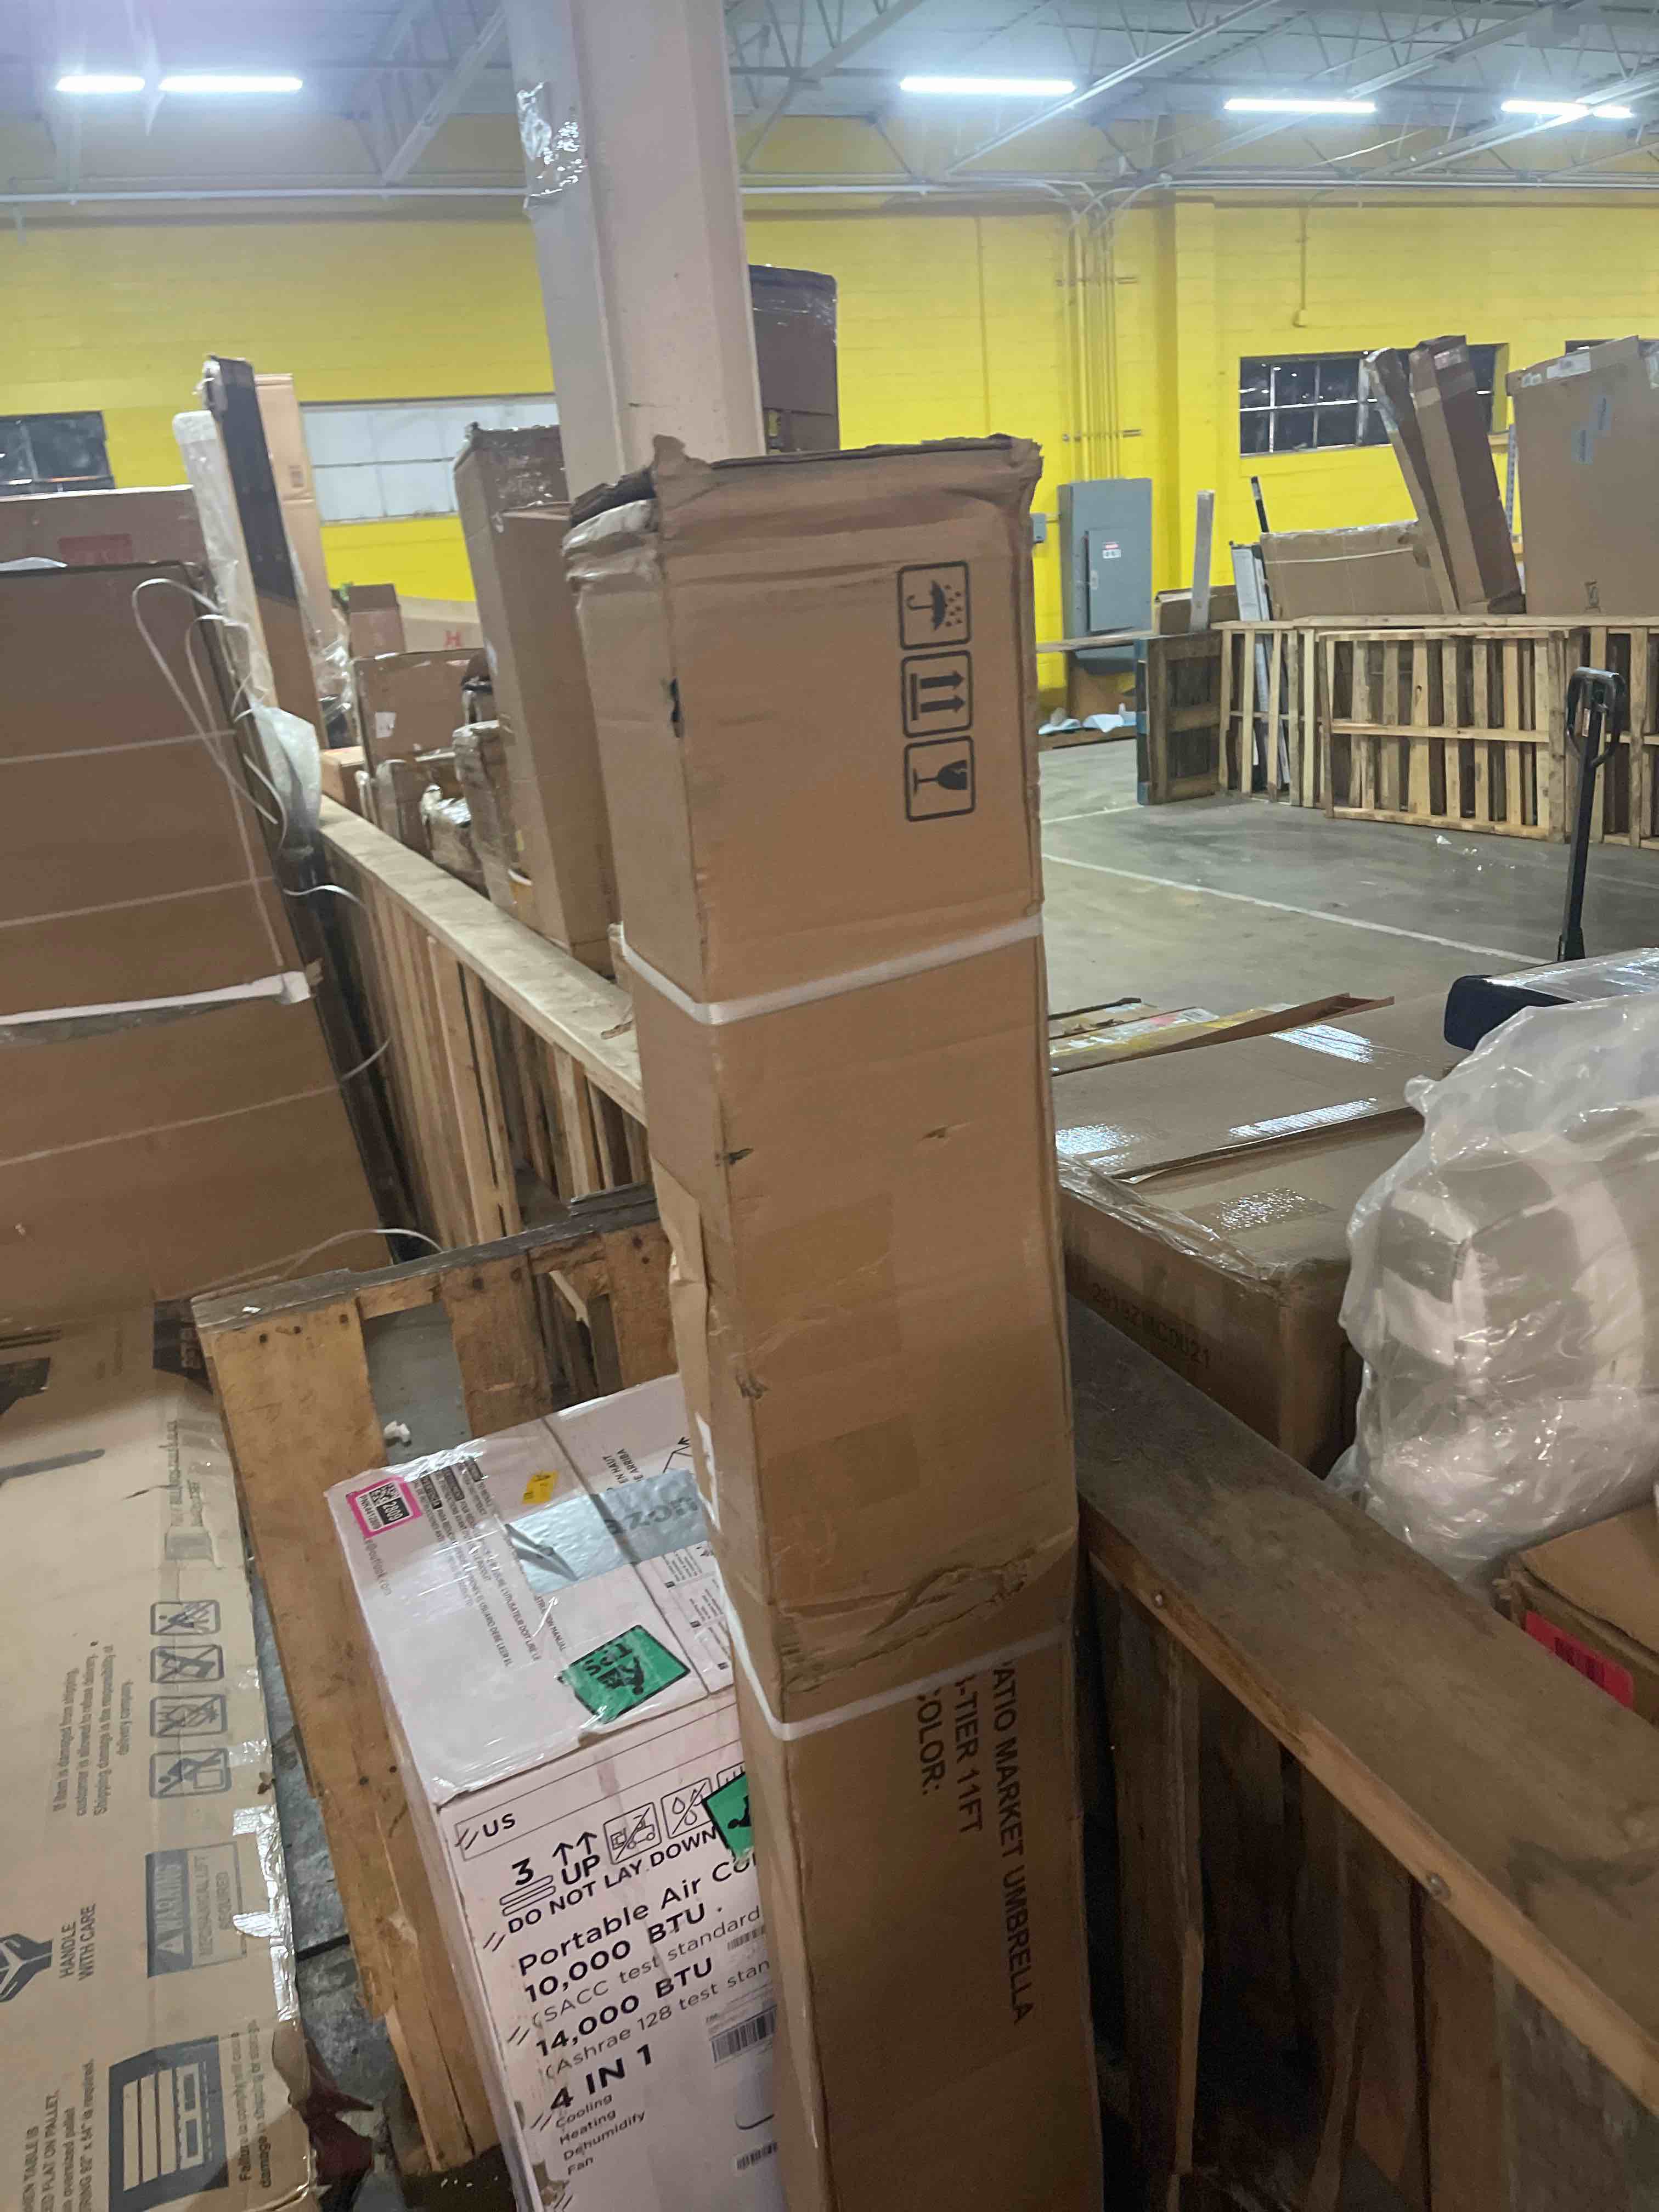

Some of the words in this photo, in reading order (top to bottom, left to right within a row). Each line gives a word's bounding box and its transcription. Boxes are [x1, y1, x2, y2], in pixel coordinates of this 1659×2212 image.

[602, 1455, 620, 1474] HAUT
[617, 1449, 640, 1474] ARRIBA
[382, 1500, 404, 1521] 2809
[517, 1624, 532, 1640] DOIT
[548, 1624, 568, 1652] MANUAL
[994, 1661, 1018, 1732] ATIO
[95, 1733, 113, 1769] damage
[917, 1688, 946, 1796] OLOR:
[93, 1770, 112, 1816] Shipping
[957, 1768, 984, 1833] 11FT
[995, 1736, 1024, 1858] MARKET
[483, 1813, 516, 1837] US
[508, 1909, 541, 1934] DO
[549, 1880, 596, 1915] NOT
[604, 1859, 642, 1888] LAY
[650, 1826, 717, 1867] DOWN
[512, 1857, 534, 1886] 3
[561, 1854, 601, 1885] UP
[78, 1903, 97, 1945] CARE
[518, 1904, 648, 1976] Portable
[661, 1877, 701, 1910] Air
[1002, 1864, 1035, 2027] UMBRELLA
[59, 1921, 78, 1980] HANDLE
[77, 1946, 96, 1982] WITH
[524, 1940, 631, 2002] 10,000
[647, 1903, 705, 1945] BTU
[532, 1979, 609, 2029] (SACC
[618, 1955, 660, 1984] test
[667, 1904, 761, 1962] standard
[535, 1994, 640, 2057] 14,000
[655, 1956, 713, 1999] BTU
[545, 2028, 631, 2080] (Ashrae
[636, 2005, 673, 2031] 128
[678, 1982, 720, 2011] test
[550, 2086, 574, 2110] 4
[585, 2057, 625, 2095] IN
[636, 2043, 652, 2066] 1
[63, 2107, 75, 2138] pallet
[555, 2093, 613, 2129] Cooling
[559, 2109, 617, 2146] Heating
[42, 2139, 56, 2159] ON
[563, 2110, 646, 2162] Dehumidify
[23, 2141, 38, 2181] TABLE
[42, 2161, 55, 2192] FLAT
[62, 2141, 75, 2197] oversized
[238, 2138, 252, 2182] Failure
[257, 2135, 272, 2188] damage
[567, 2156, 594, 2175] Fan
